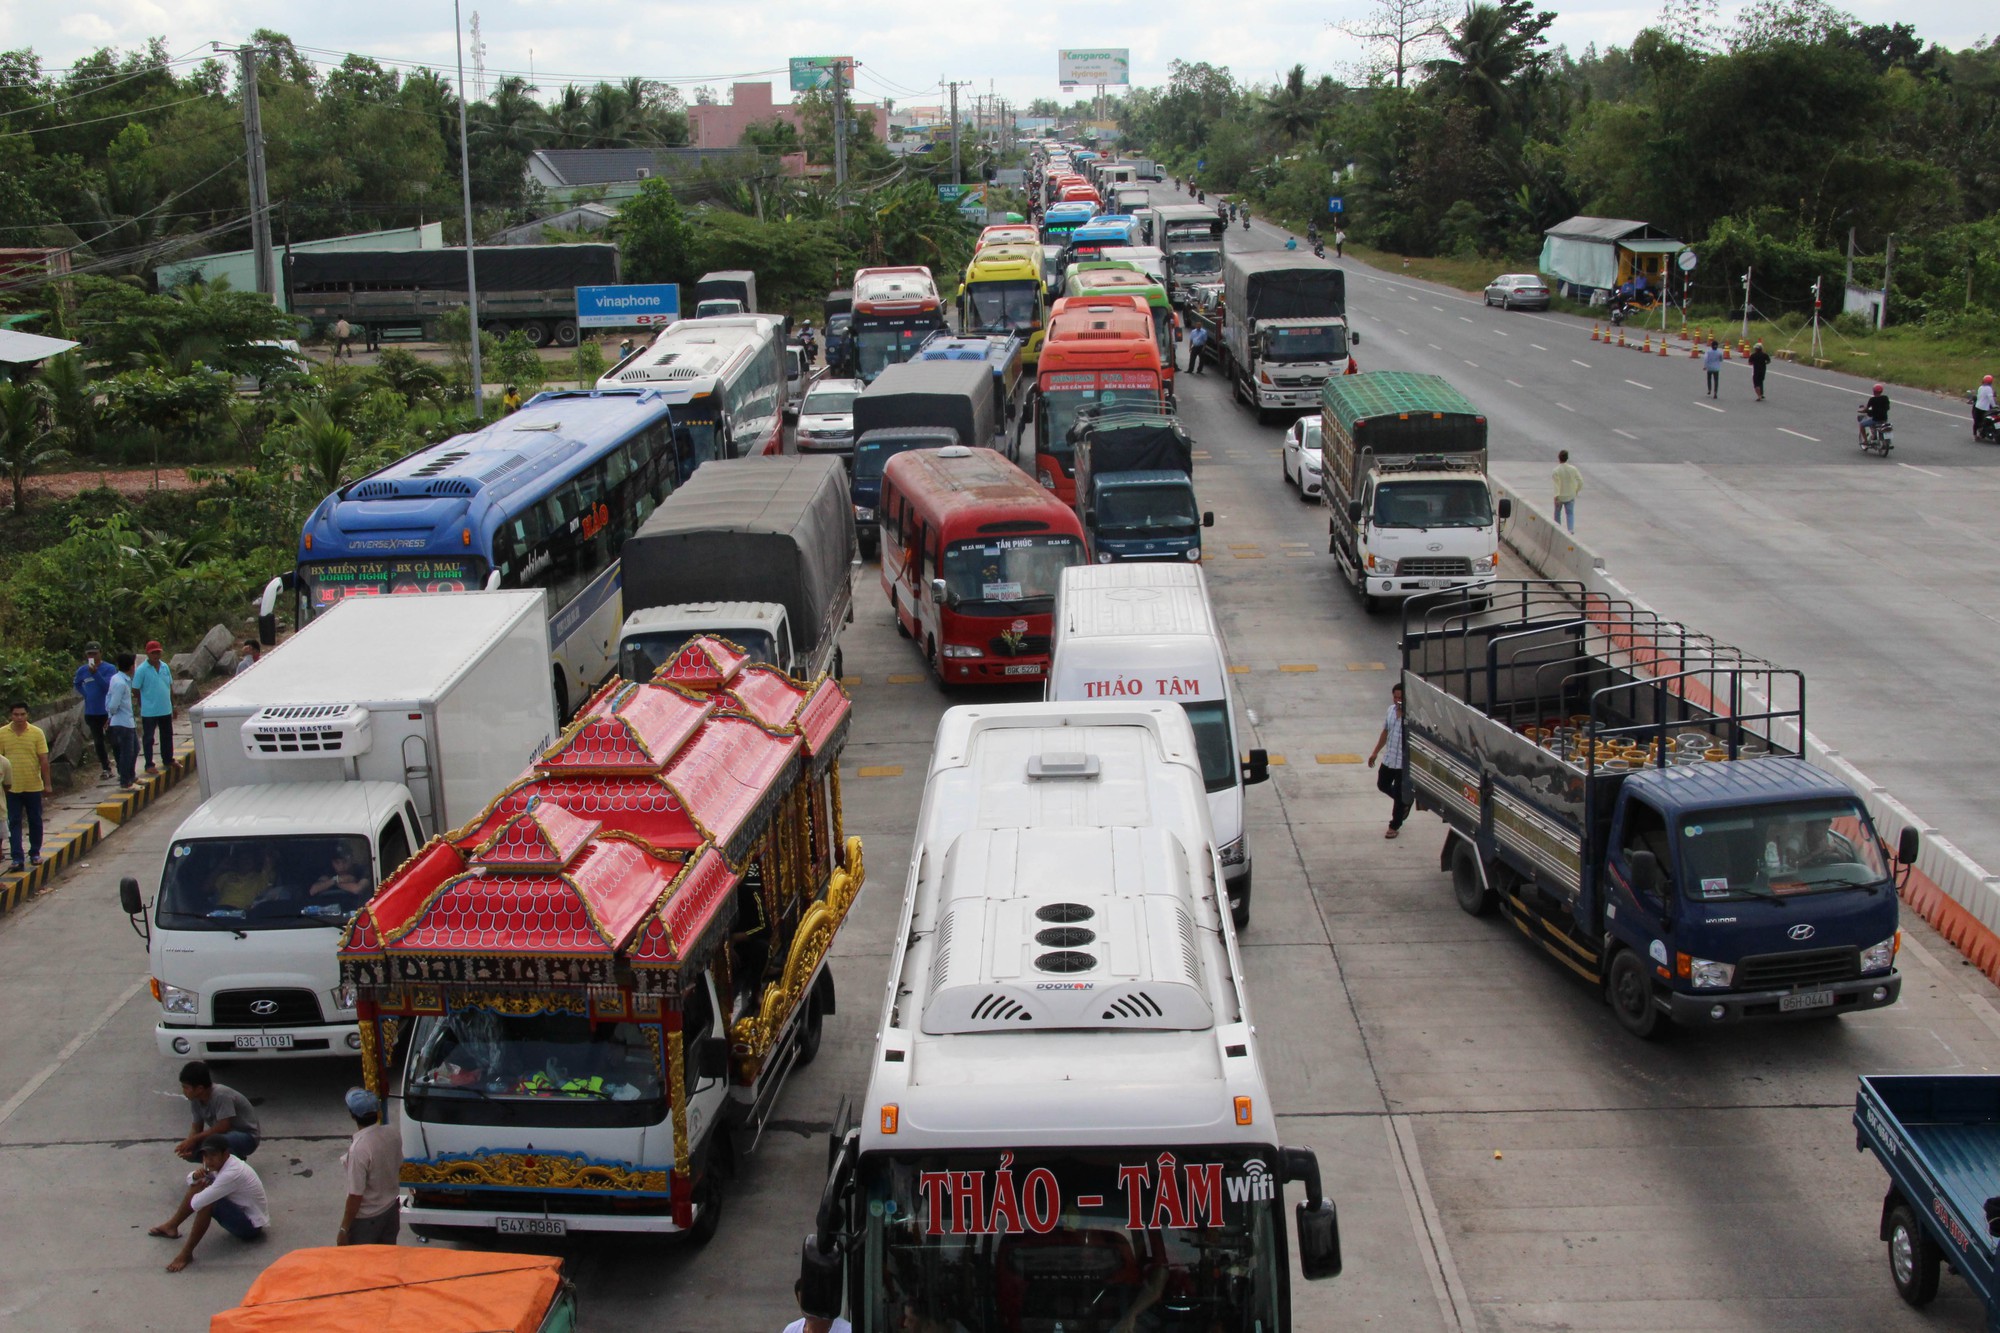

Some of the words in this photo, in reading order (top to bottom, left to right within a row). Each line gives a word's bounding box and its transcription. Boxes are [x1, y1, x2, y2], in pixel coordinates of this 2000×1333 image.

[1063, 51, 1111, 61] Kangaroo
[1071, 71, 1108, 79] Hydrogen
[596, 295, 661, 308] vinaphone
[581, 501, 609, 541] HẢO
[1012, 538, 1033, 548] PHÚC
[311, 567, 325, 575] BX
[328, 562, 357, 574] MIỀN
[396, 564, 412, 572] BX
[414, 561, 431, 572] CÀ
[433, 562, 461, 571] MAU
[1084, 674, 1143, 698] THẢO
[1155, 675, 1200, 695] TÂM
[1783, 994, 1830, 1009] 95H-0441
[919, 1151, 1061, 1235] THẢO
[1117, 1152, 1226, 1229] TÂM
[1226, 1173, 1275, 1203] Wifi
